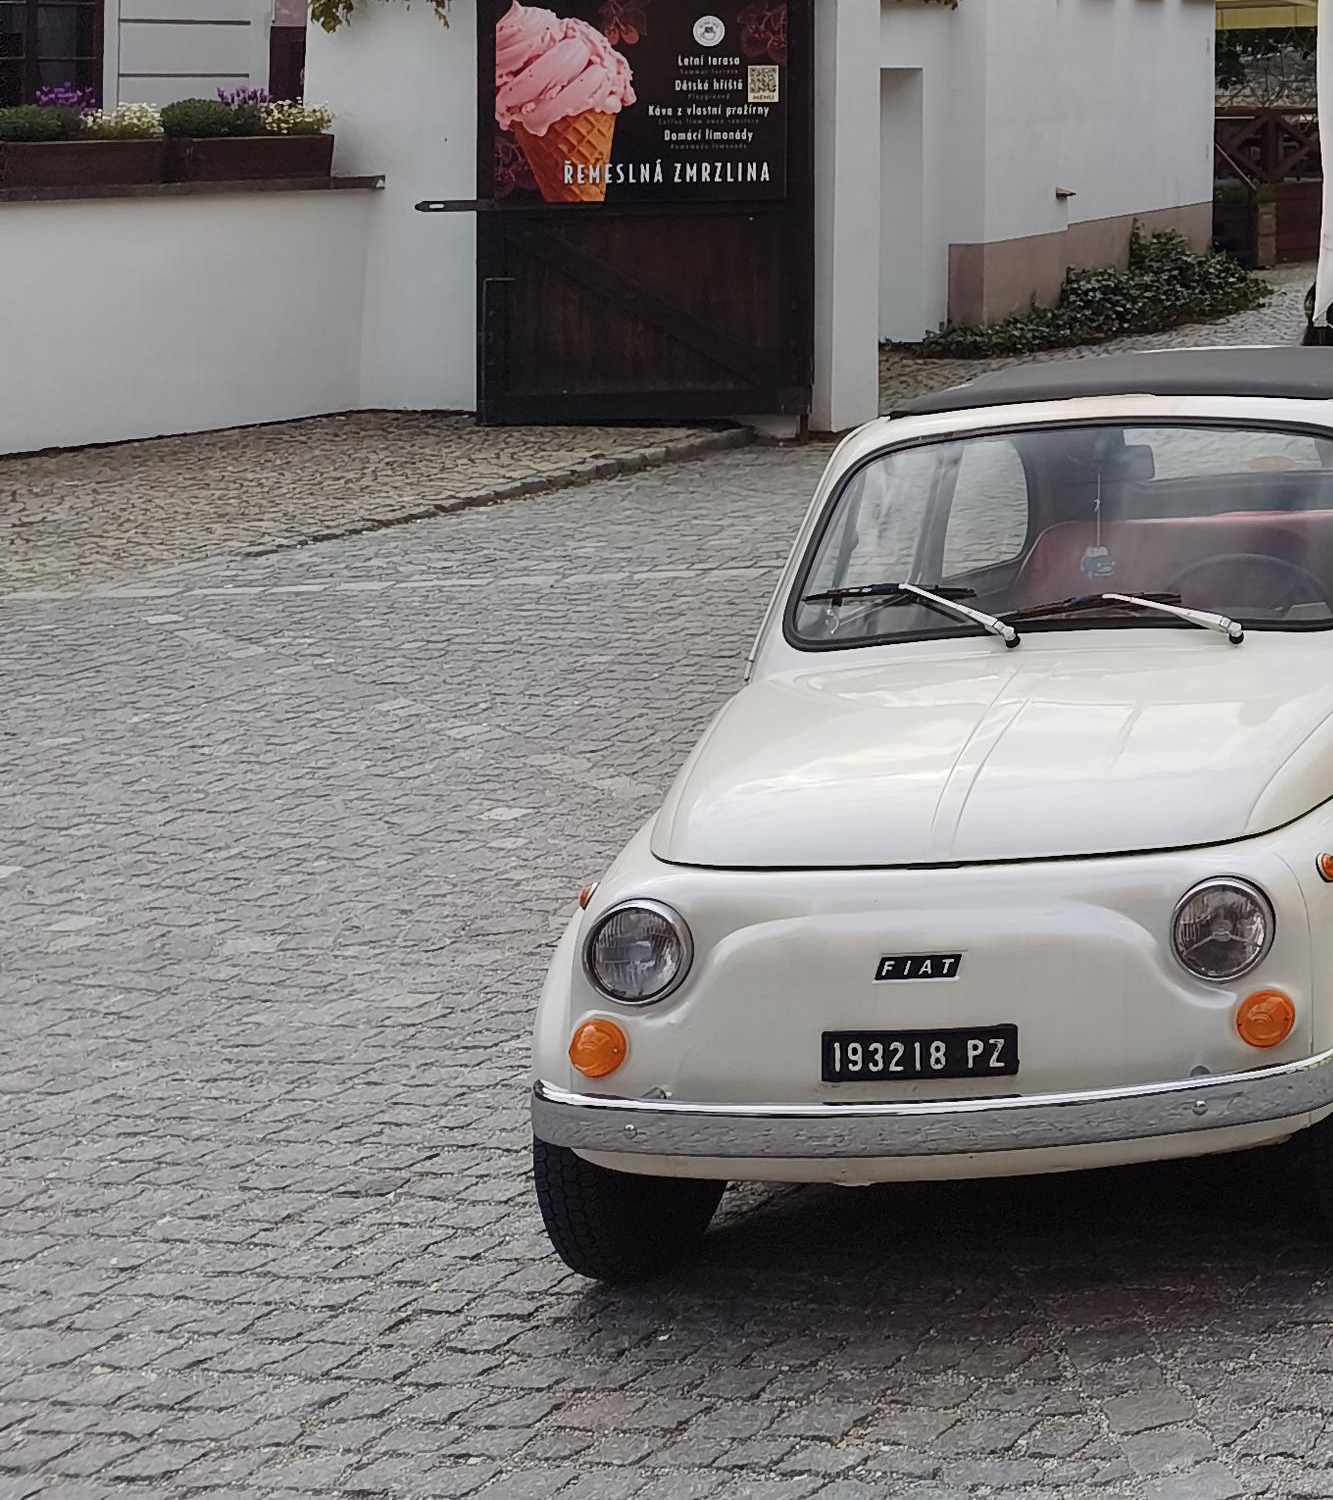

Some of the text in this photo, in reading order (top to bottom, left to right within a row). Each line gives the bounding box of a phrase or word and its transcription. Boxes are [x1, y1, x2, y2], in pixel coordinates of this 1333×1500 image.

[678, 55, 704, 66] Letní
[675, 79, 709, 91] Dětské
[648, 105, 673, 116] Káva
[687, 103, 722, 116] vlastní
[664, 128, 753, 142] Domácí limonády
[564, 159, 770, 184] ŘEMESLNÁ ZMRZLINA
[881, 958, 955, 976] FIAT
[833, 1038, 1005, 1072] 193218 PZ
